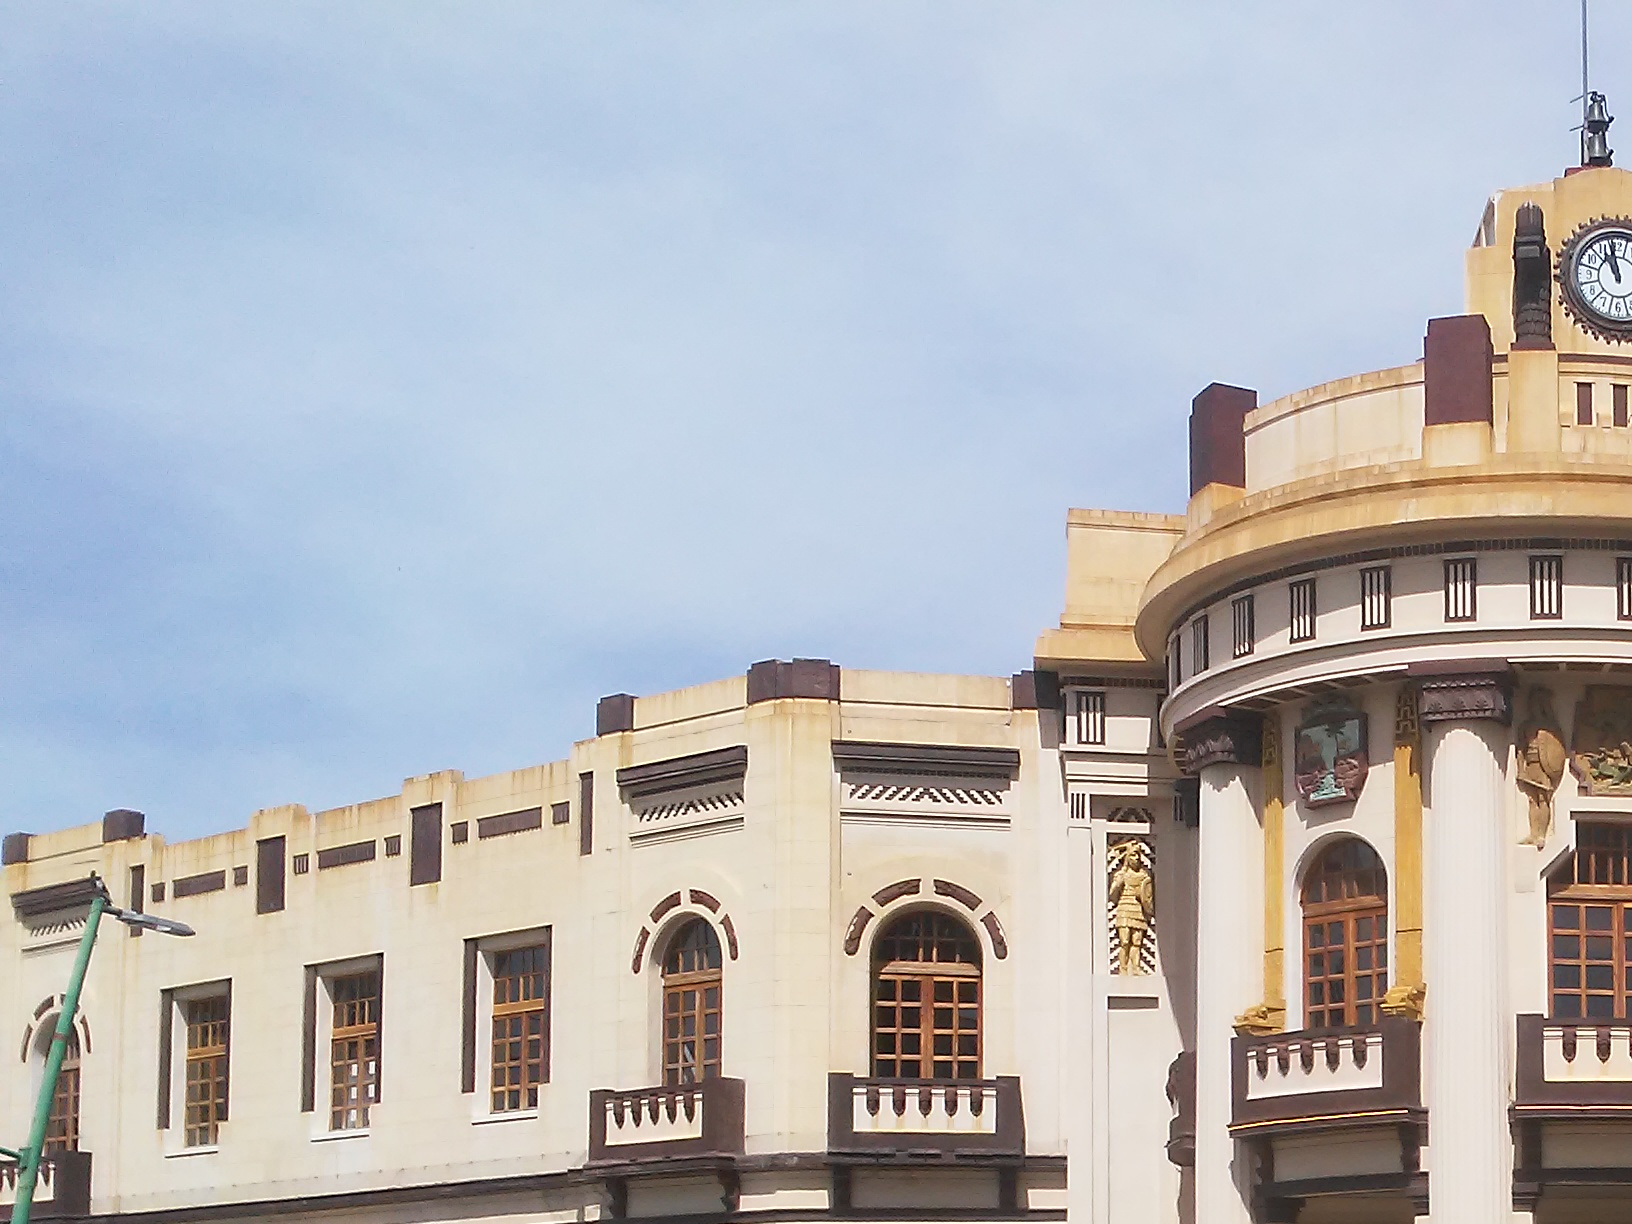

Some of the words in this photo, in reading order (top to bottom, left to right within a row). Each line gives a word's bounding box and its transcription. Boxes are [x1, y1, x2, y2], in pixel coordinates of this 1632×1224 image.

[1588, 253, 1597, 264] 10
[1586, 270, 1592, 280] 9
[1590, 285, 1596, 295] 8
[1600, 296, 1607, 307] 7
[1615, 302, 1621, 313] 6
